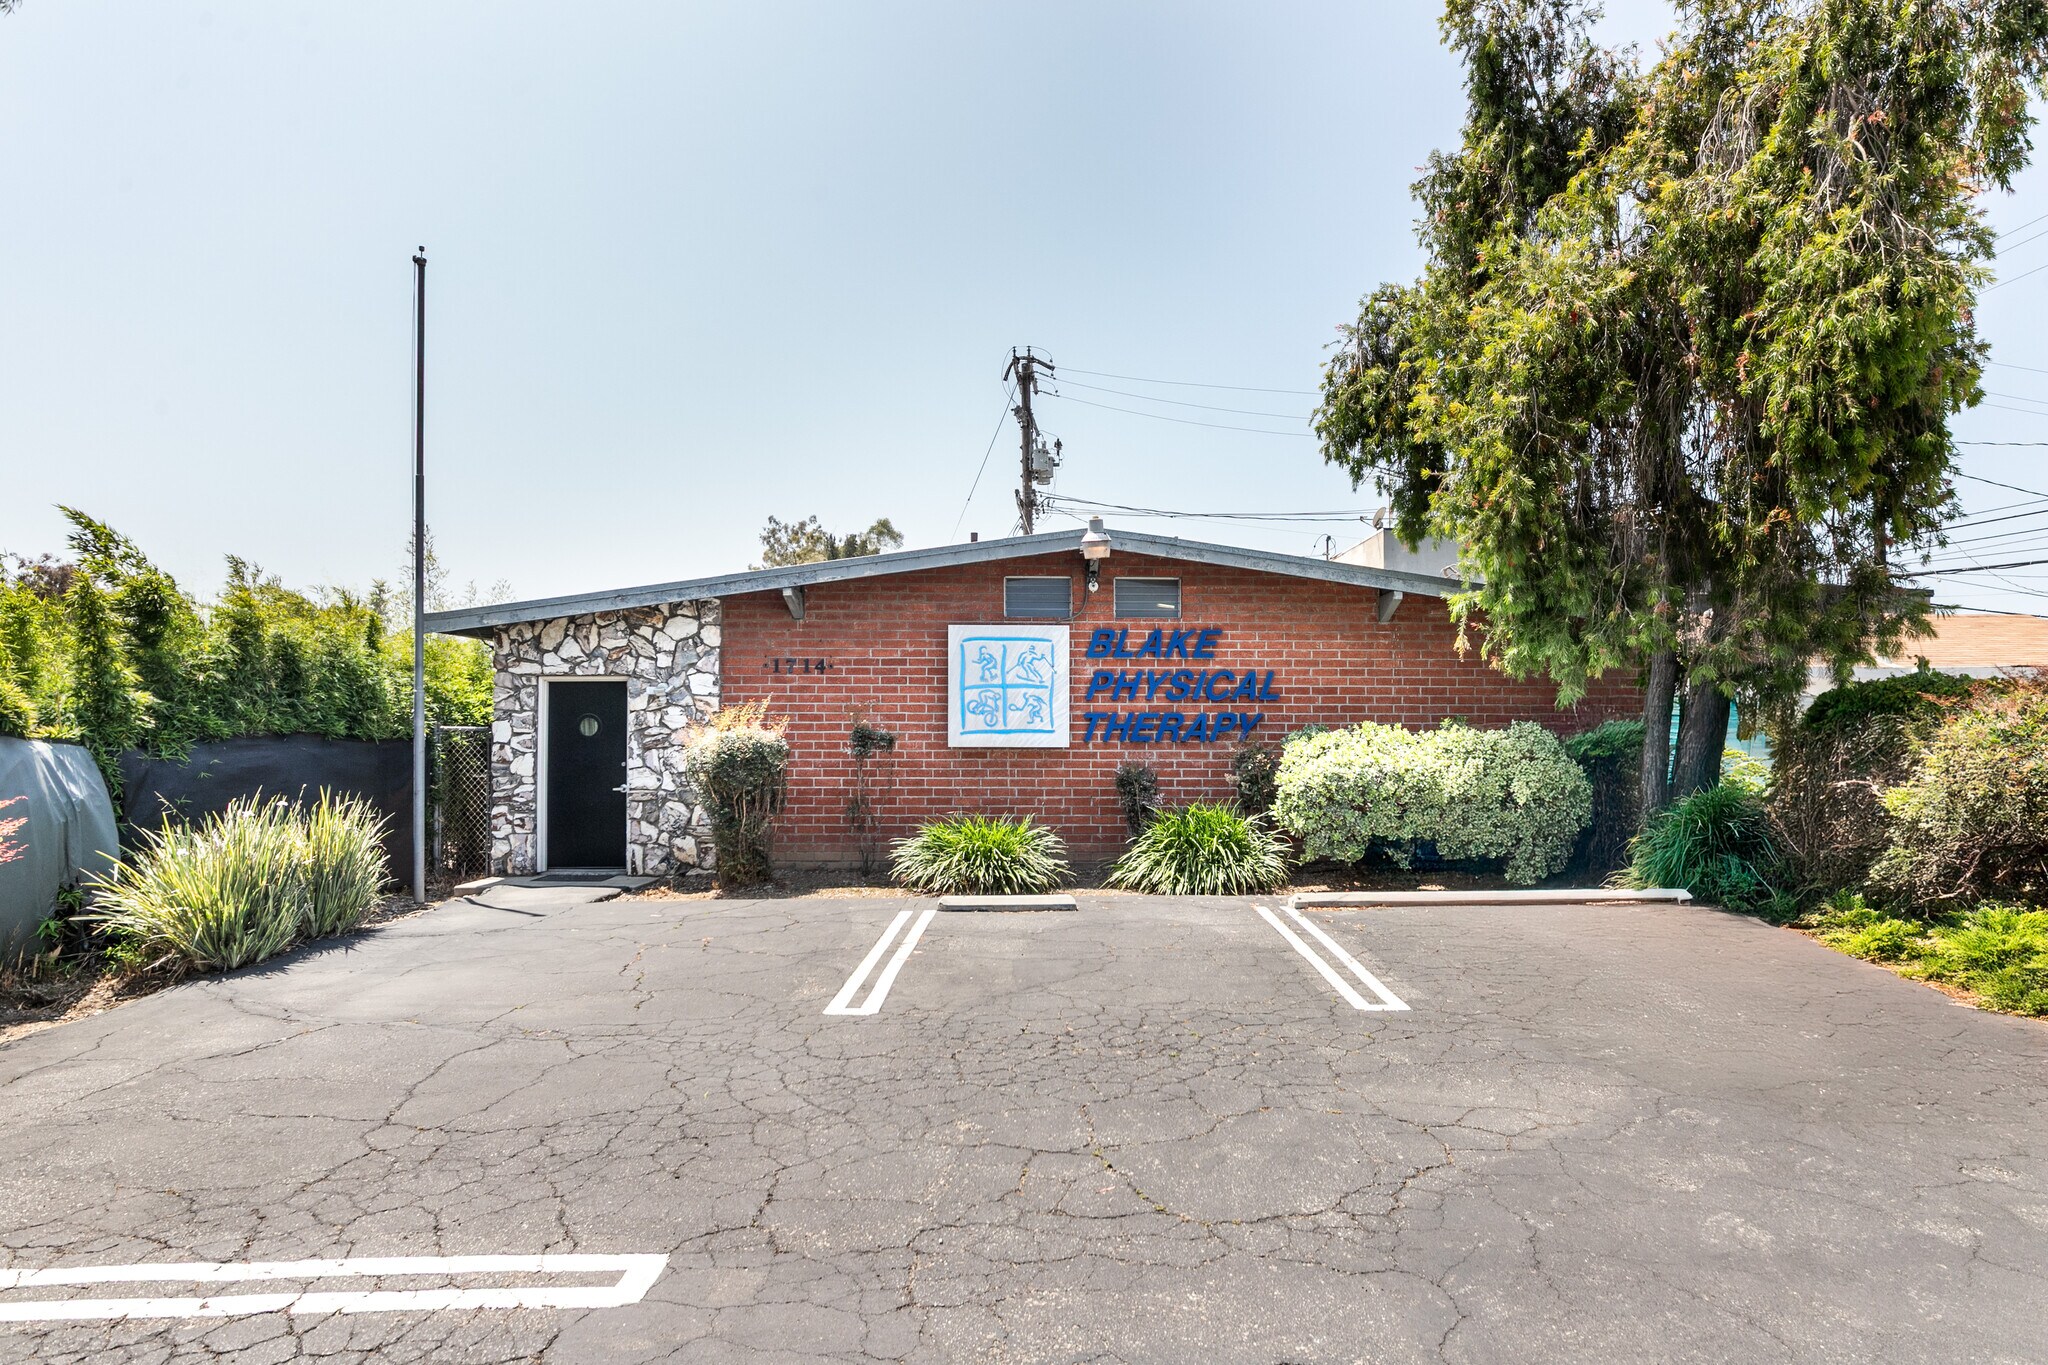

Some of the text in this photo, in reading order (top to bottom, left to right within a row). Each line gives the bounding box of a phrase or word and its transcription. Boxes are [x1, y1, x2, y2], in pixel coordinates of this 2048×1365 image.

[1086, 628, 1223, 659] BLAKE
[773, 658, 826, 674] 1714
[1085, 669, 1281, 701] PHYSICAL
[1084, 712, 1264, 743] THERAPY
